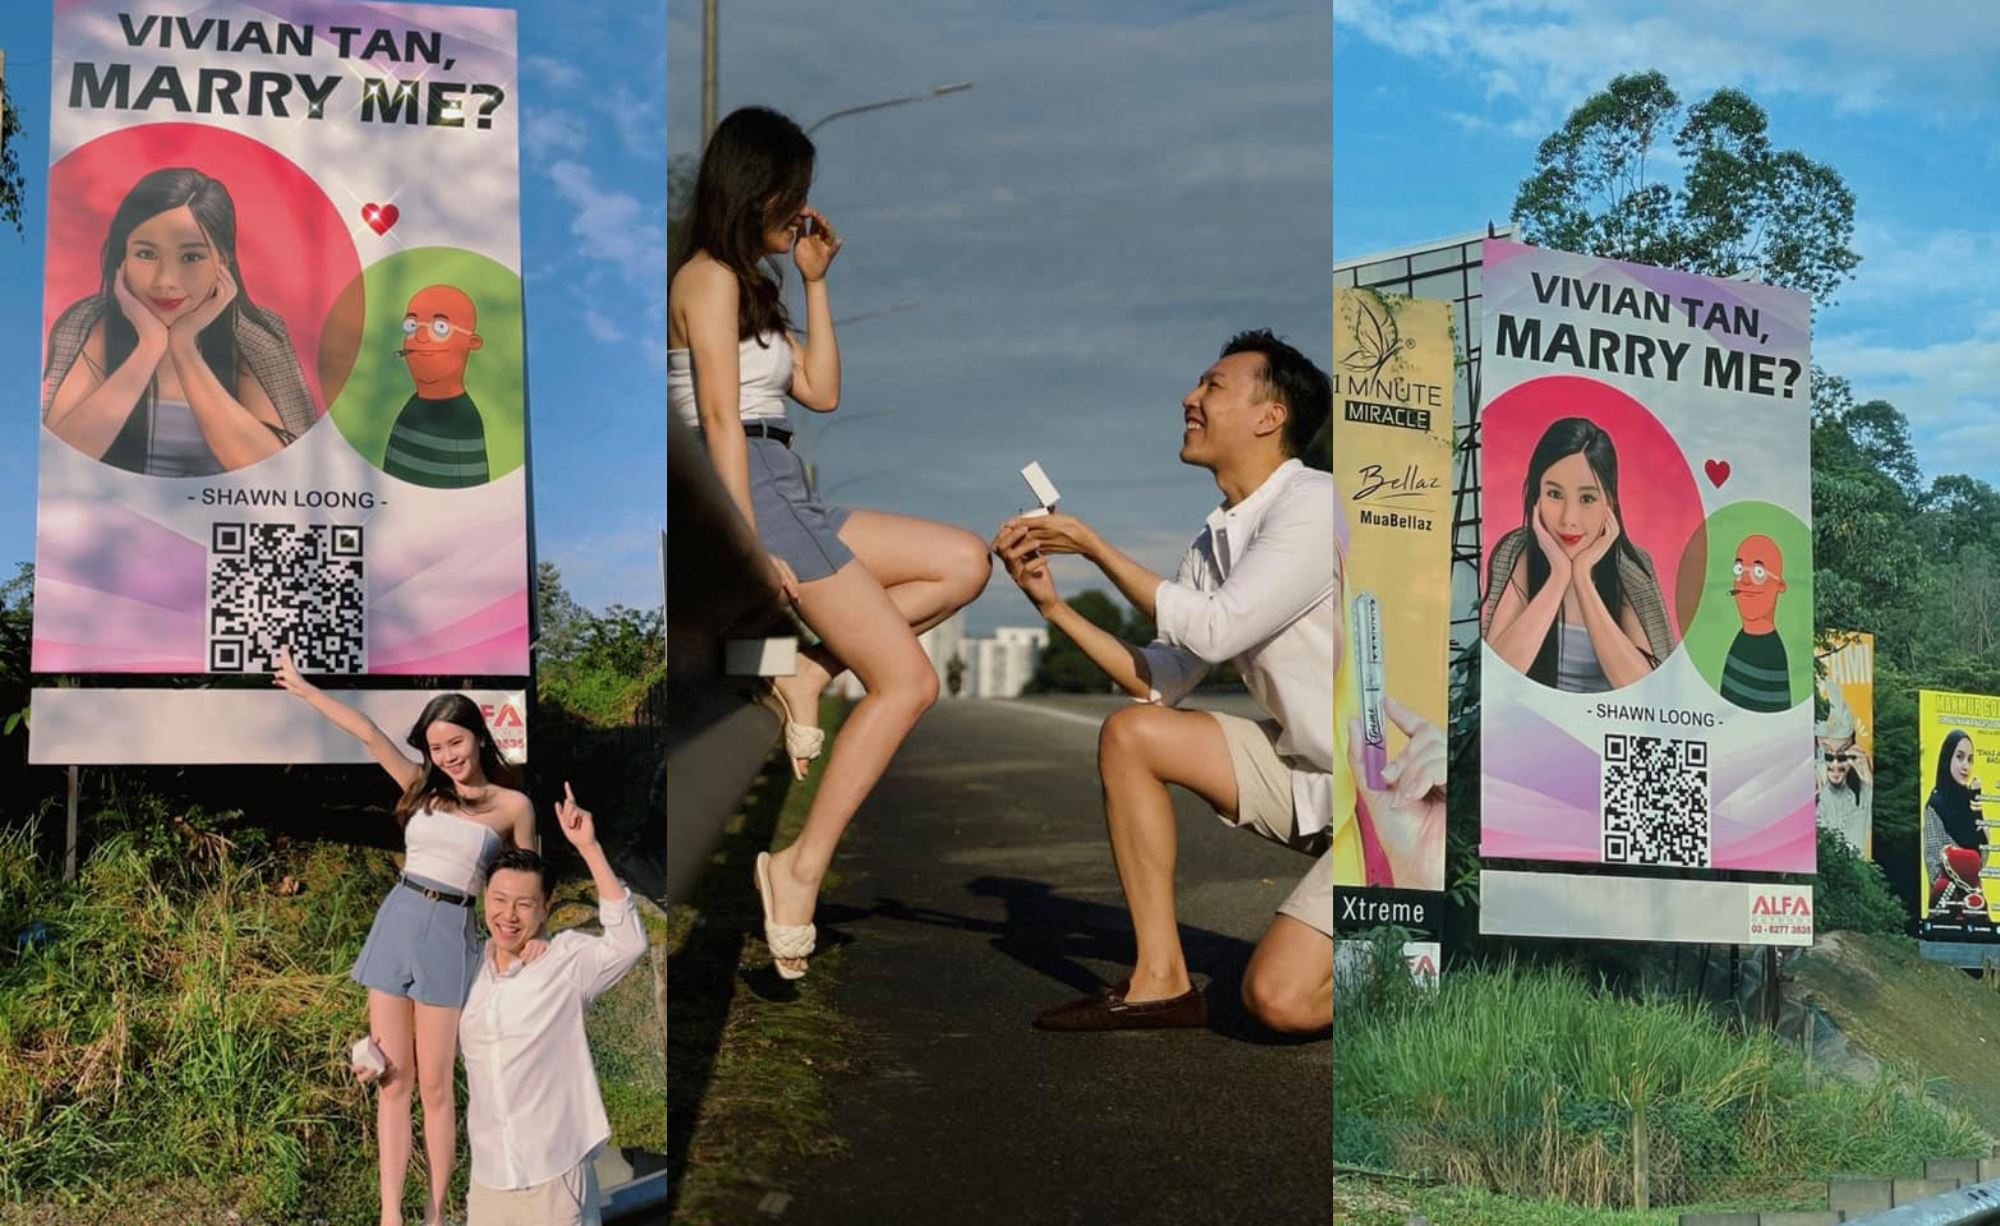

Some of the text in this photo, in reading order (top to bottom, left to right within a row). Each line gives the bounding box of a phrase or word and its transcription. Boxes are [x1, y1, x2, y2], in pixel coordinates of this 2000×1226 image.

[118, 13, 456, 70] VIVIAN TAN,
[68, 62, 505, 129] MARRY ME?
[1531, 272, 1769, 344] VIVIAN TAN,
[1496, 314, 1801, 399] MARRY ME?
[1349, 402, 1428, 429] MIRACLE
[201, 488, 287, 506] SHAWN
[294, 490, 375, 509] LOONG
[1360, 510, 1433, 531] MuaBellaz
[481, 704, 523, 727] FA
[1596, 703, 1655, 722] SHAWN
[1660, 709, 1715, 727] LOONG
[1342, 896, 1425, 923] Xtreme
[1752, 895, 1811, 916] ALFA
